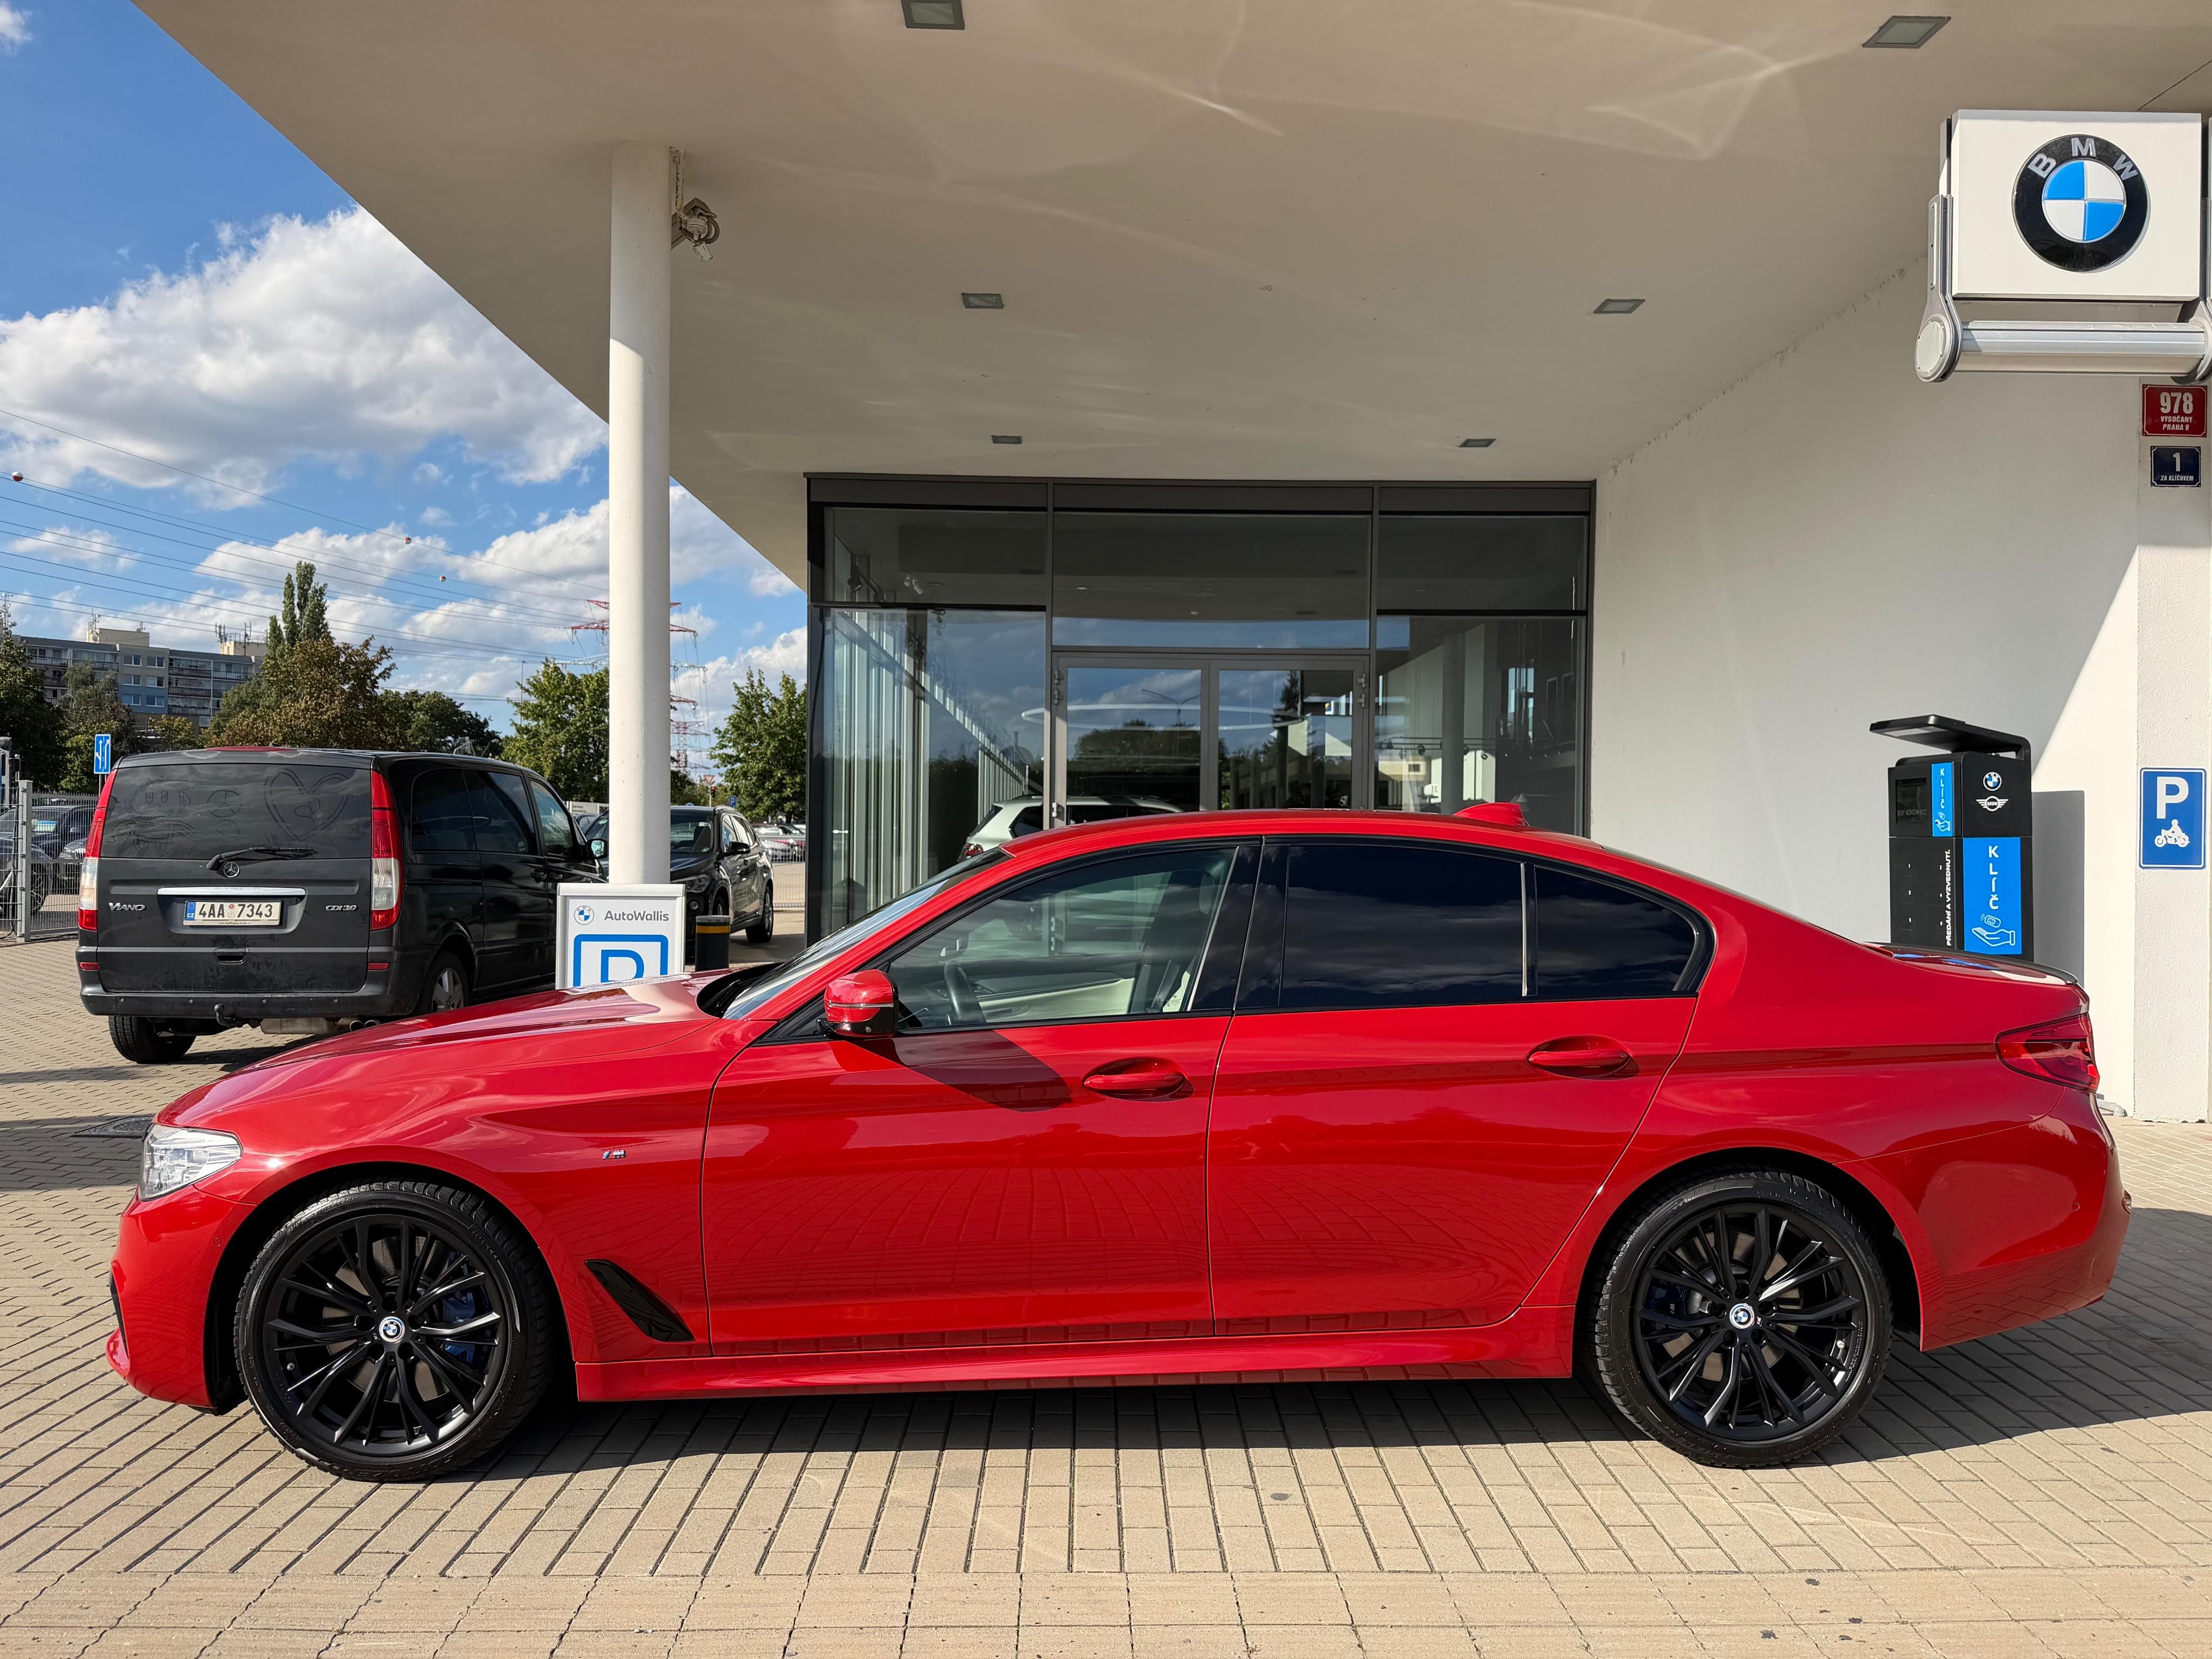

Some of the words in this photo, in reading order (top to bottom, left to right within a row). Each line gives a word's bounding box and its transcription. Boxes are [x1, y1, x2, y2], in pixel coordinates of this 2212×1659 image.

[2027, 137, 2139, 181] BMW
[2160, 392, 2194, 414] 978
[2160, 415, 2193, 423] VYSOČANY
[2173, 452, 2181, 472] 1
[2156, 776, 2189, 819] P
[1988, 845, 1999, 910] KLÍČ
[198, 903, 225, 918] 4AA
[237, 903, 273, 918] 7343
[604, 910, 670, 921] AutoWallis
[601, 949, 645, 983] P
